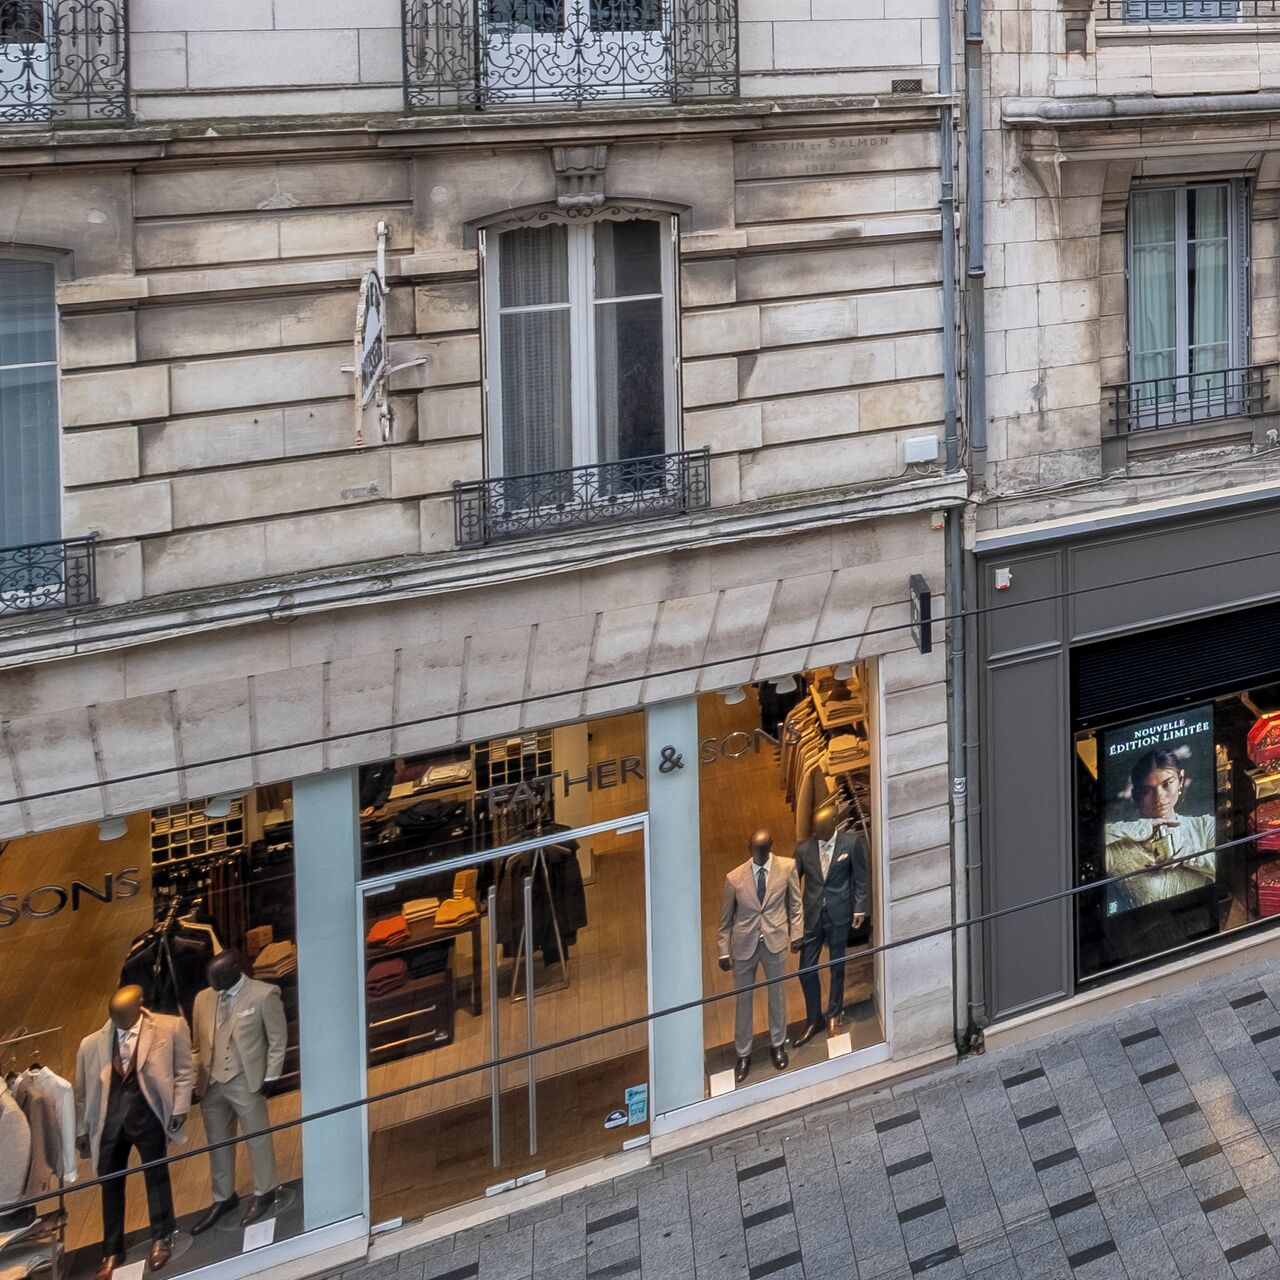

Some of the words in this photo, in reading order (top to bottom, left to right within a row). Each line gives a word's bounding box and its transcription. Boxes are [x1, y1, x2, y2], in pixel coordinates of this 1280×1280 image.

[1109, 735, 1160, 756] ÉDITION
[1163, 721, 1210, 741] LIMITÉE
[1134, 719, 1186, 739] NOUVELLE
[488, 754, 646, 812] FATHER
[658, 744, 686, 774] &
[700, 719, 803, 763] SONS
